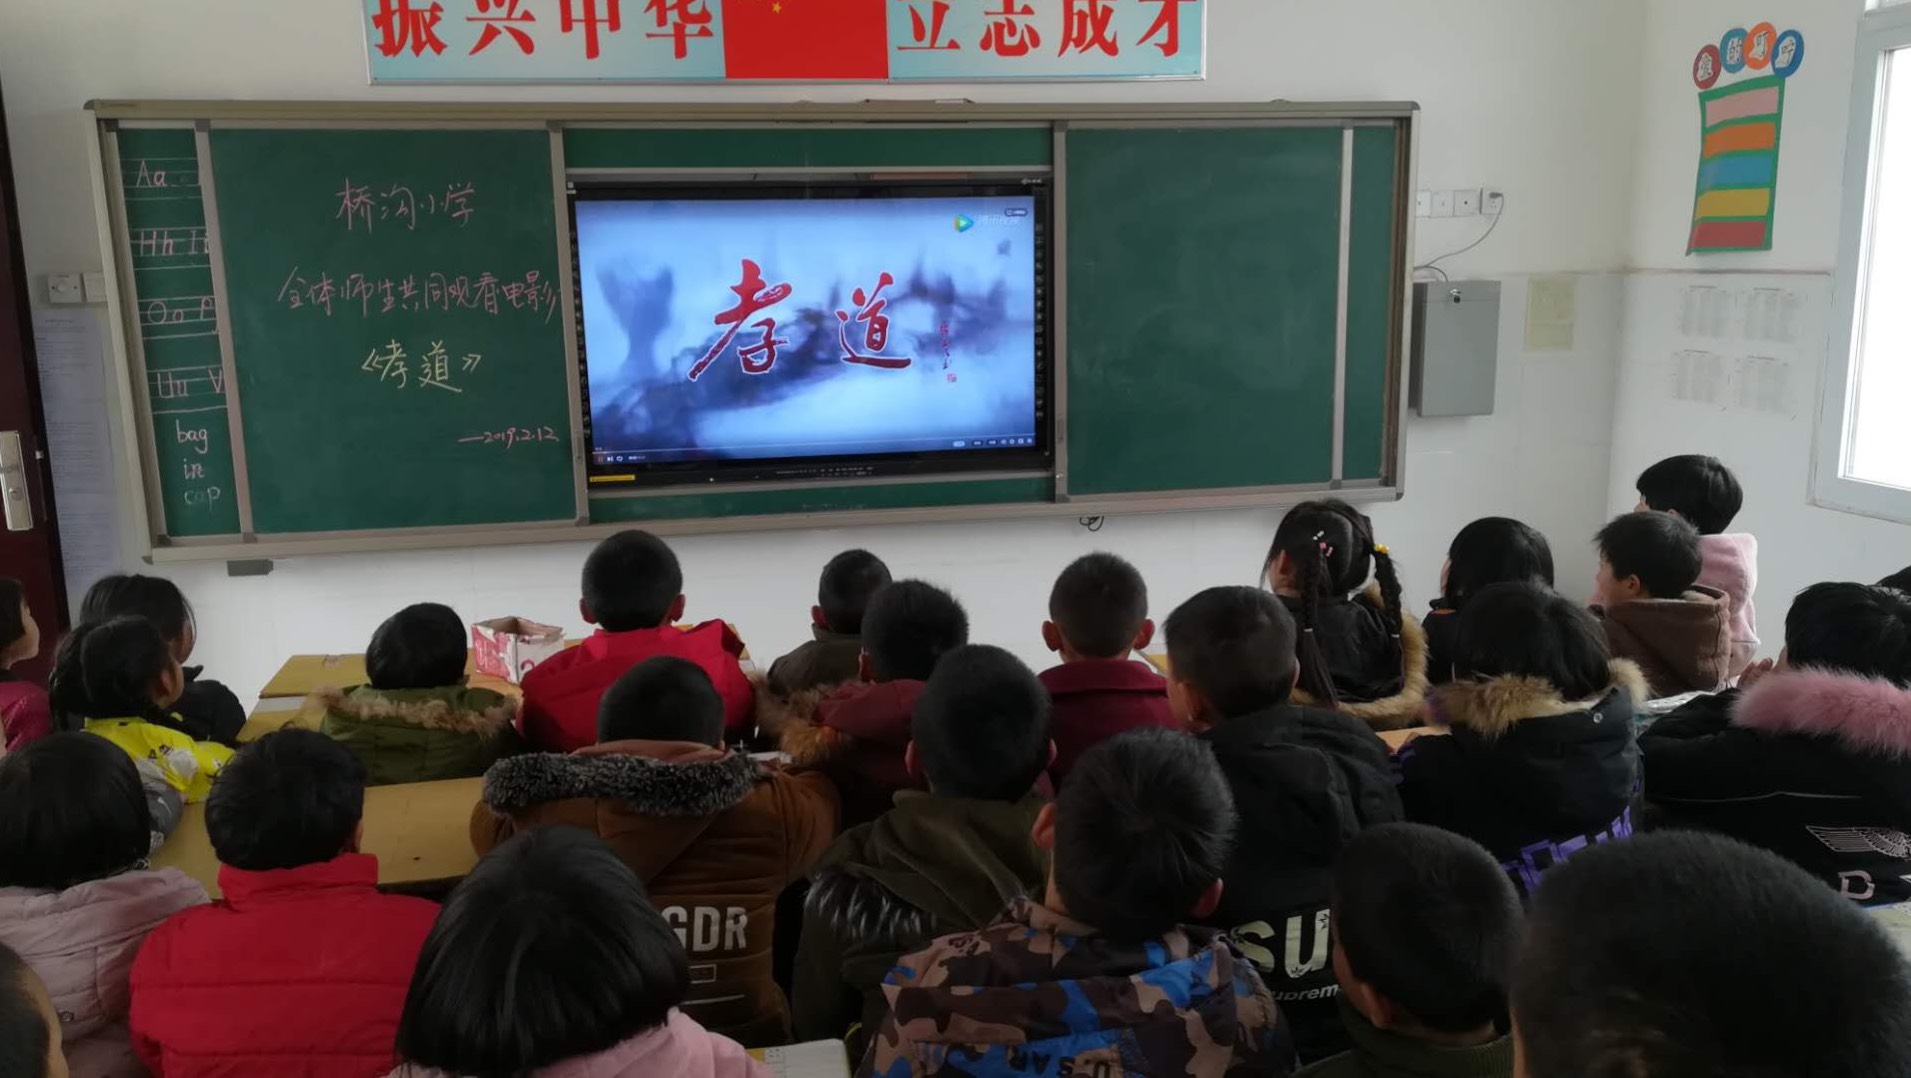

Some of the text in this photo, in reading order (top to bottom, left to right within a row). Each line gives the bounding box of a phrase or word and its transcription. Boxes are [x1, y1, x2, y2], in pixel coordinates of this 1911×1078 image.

[371, 0, 714, 60] 振兴中华
[896, 0, 1197, 58] 立志成才
[136, 159, 167, 188] Aa
[335, 176, 476, 233] 桥沟小学
[140, 230, 174, 256] Hh
[277, 266, 561, 325] 全体师生共同观看电影
[687, 257, 913, 382] 孝道
[175, 419, 209, 454] bag
